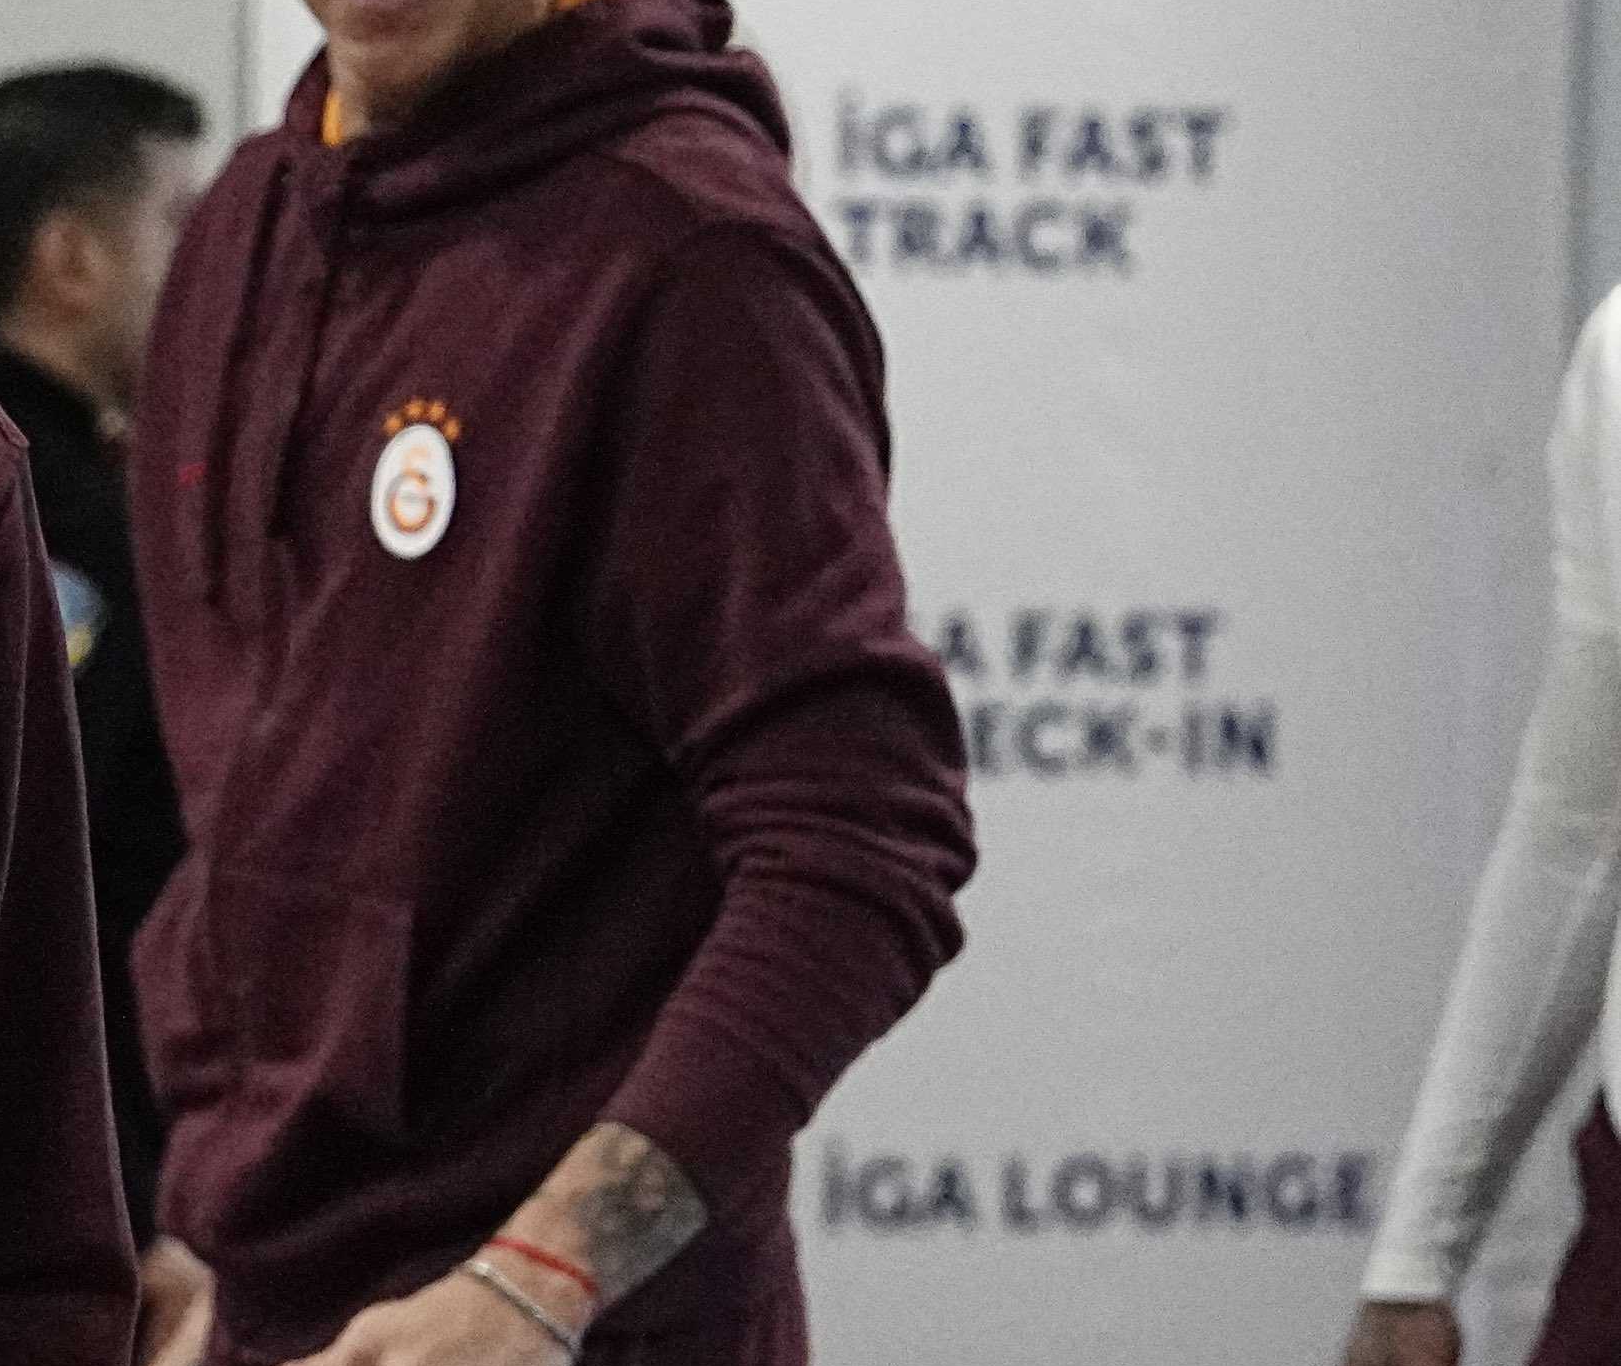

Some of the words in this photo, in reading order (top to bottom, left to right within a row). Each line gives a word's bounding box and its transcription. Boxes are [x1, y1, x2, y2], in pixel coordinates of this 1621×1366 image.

[1016, 103, 1231, 183] FAST
[839, 200, 1133, 277] TRACK
[1009, 605, 1220, 683] FAST
[969, 699, 1276, 779] ECK-IN
[1001, 1151, 1374, 1232] LOUNGE
